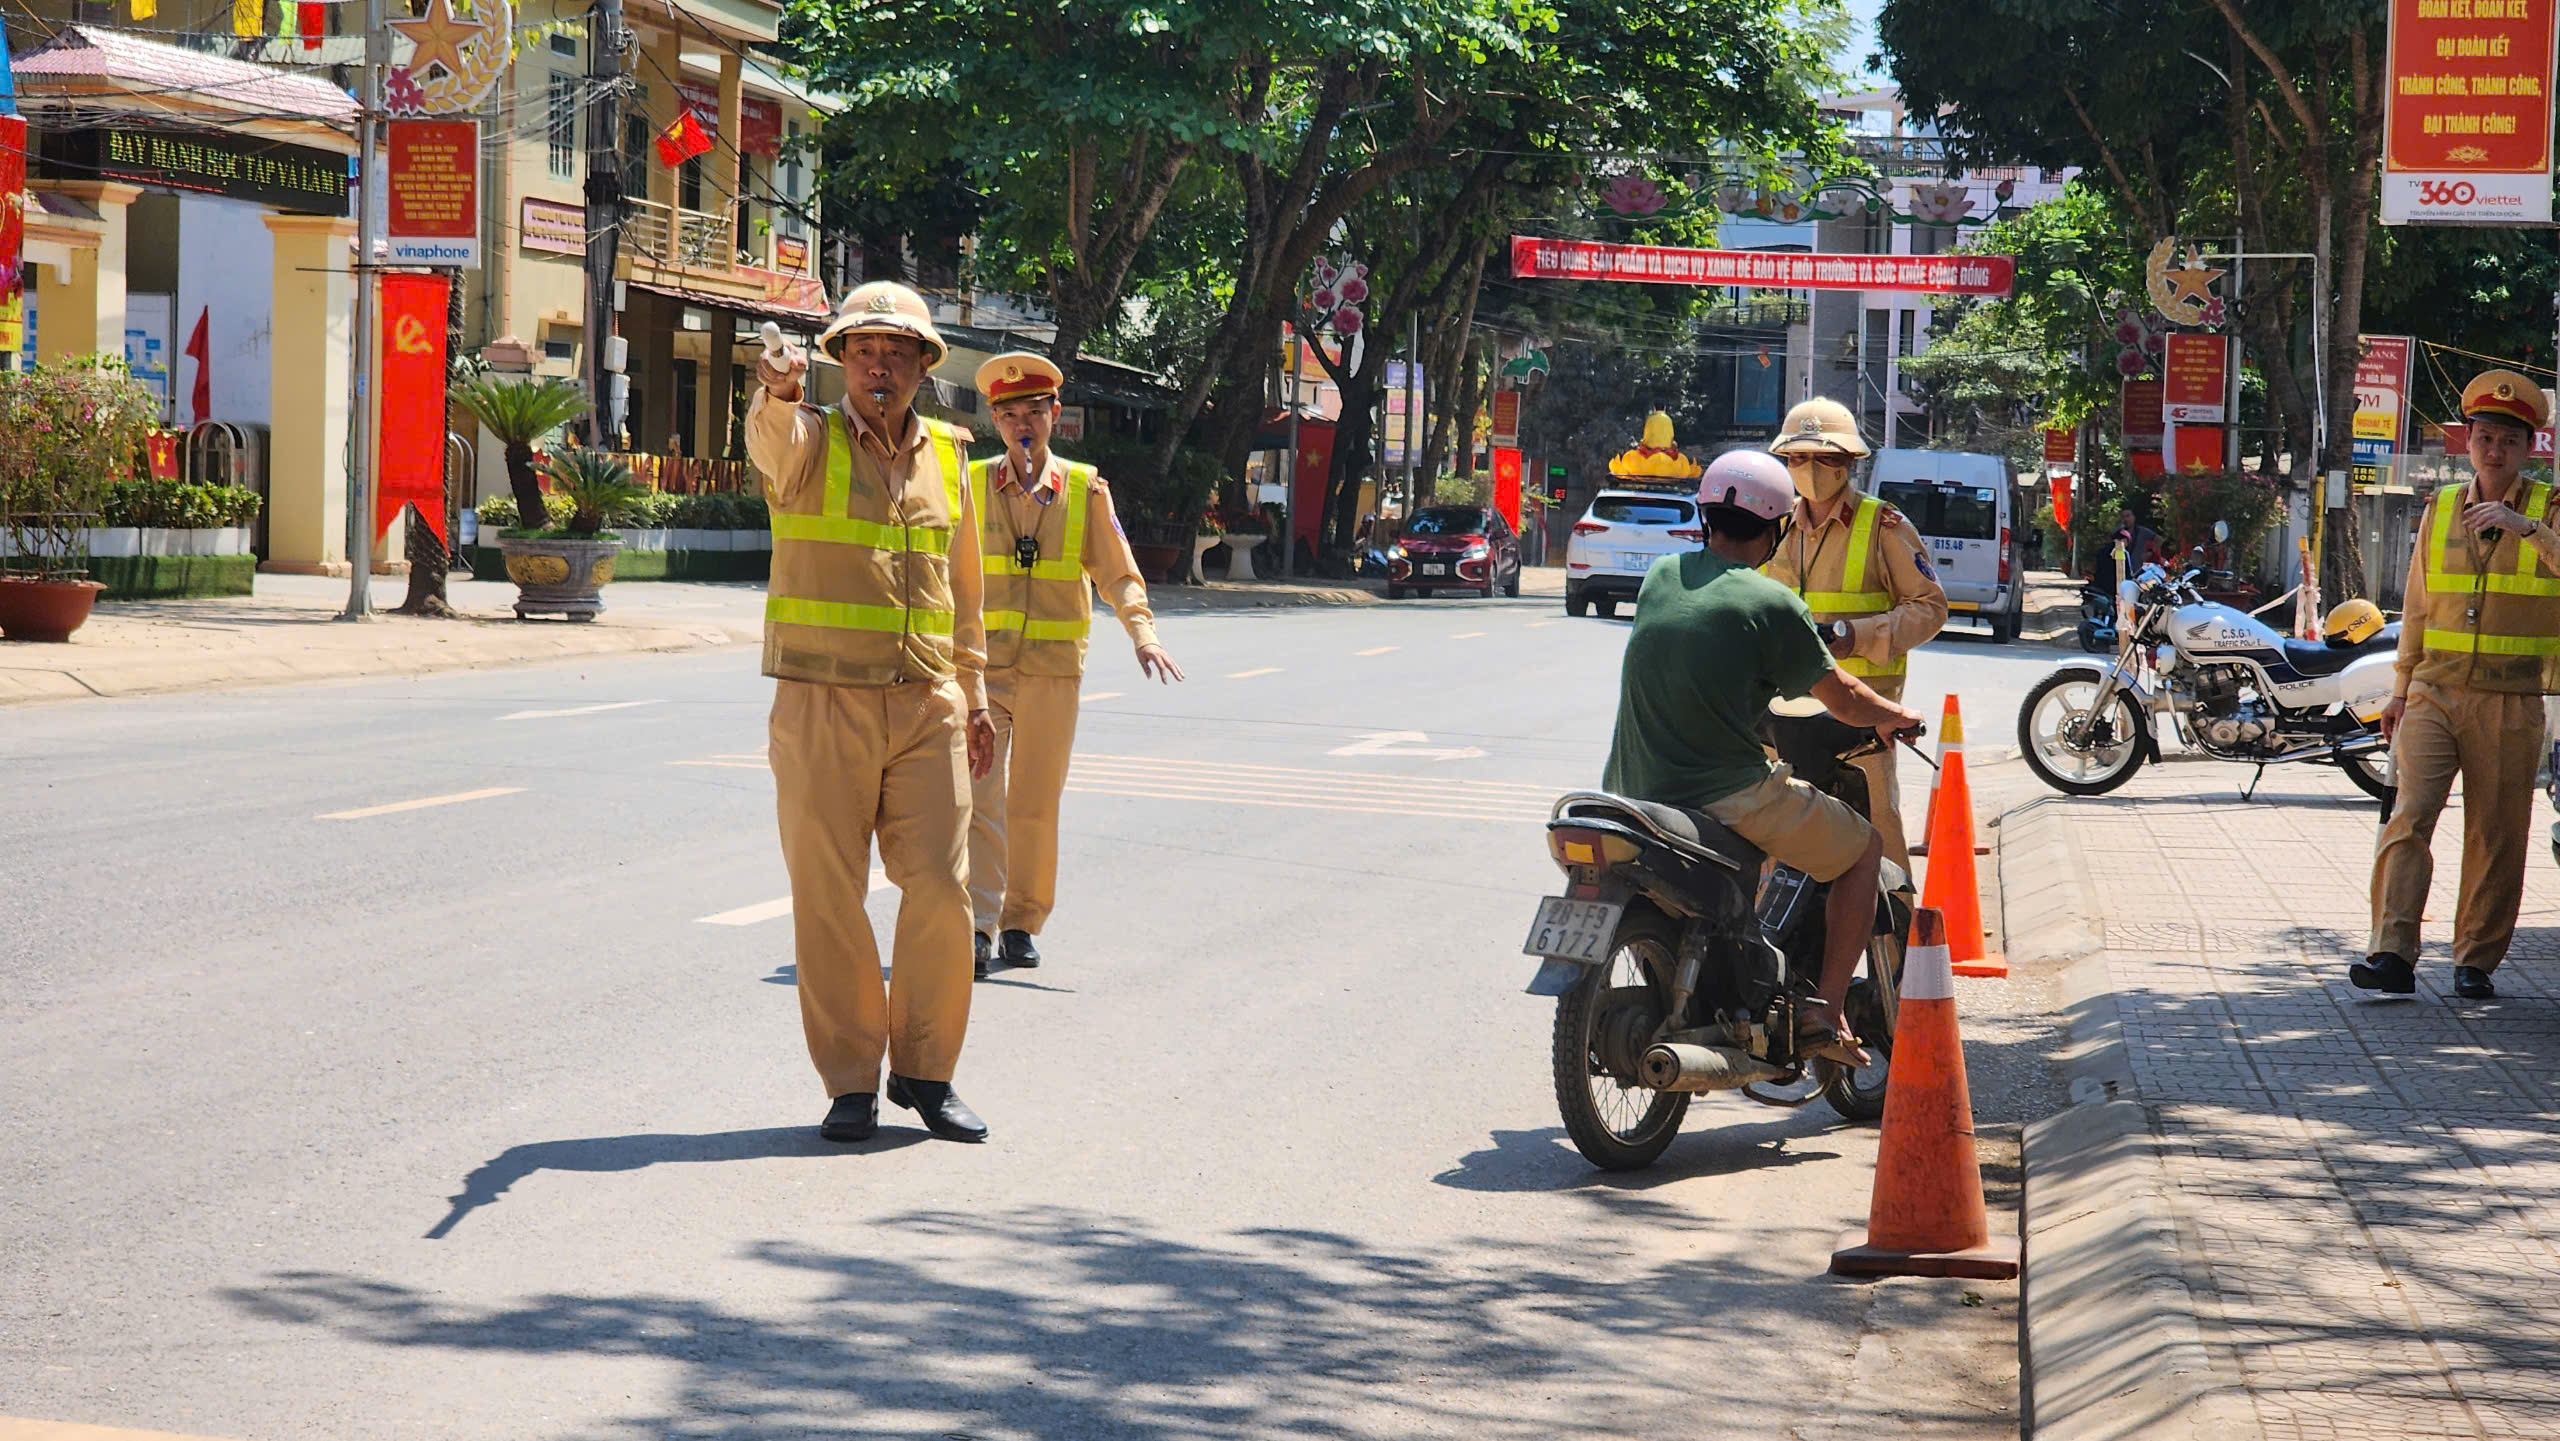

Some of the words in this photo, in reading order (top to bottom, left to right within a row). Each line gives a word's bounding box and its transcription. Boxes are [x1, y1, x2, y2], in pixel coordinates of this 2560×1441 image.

[2436, 38, 2456, 60] ĐẠI
[2457, 34, 2487, 56] ĐOÀN
[2489, 33, 2510, 56] KẾT
[2399, 72, 2434, 95] THÀNH
[2472, 73, 2507, 96] THÀNH
[2423, 115, 2443, 138] ĐẠI
[2445, 111, 2480, 134] THÀNH
[2482, 112, 2516, 134] CÔNG!
[277, 154, 299, 189] VÀ
[302, 160, 335, 195] LÀM
[2476, 195, 2523, 206] viettel
[396, 244, 469, 259] vinaphone
[1535, 247, 1558, 269] TIÊU
[1560, 248, 1589, 271] DÙNG
[1591, 247, 1613, 272] SẢN
[1615, 247, 1646, 274] PHẨM
[1648, 251, 1663, 274] VÀ
[1664, 255, 1689, 279] DỊCH
[1691, 256, 1705, 280] VỤ
[1706, 257, 1735, 277] XANH
[1737, 251, 1751, 278] ĐỂ
[1753, 255, 1774, 279] BẢO
[1777, 256, 1791, 283] VỆ
[1792, 257, 1813, 281] MÔI
[1815, 257, 1857, 282] TRƯỜNG
[1858, 259, 1873, 283] VÀ
[1875, 260, 1896, 283] SỨC
[1928, 261, 1957, 288] CỘNG
[1959, 261, 1990, 286] ĐỒNG
[2278, 680, 2315, 690] POLICE
[1536, 927, 1599, 958] 6172
